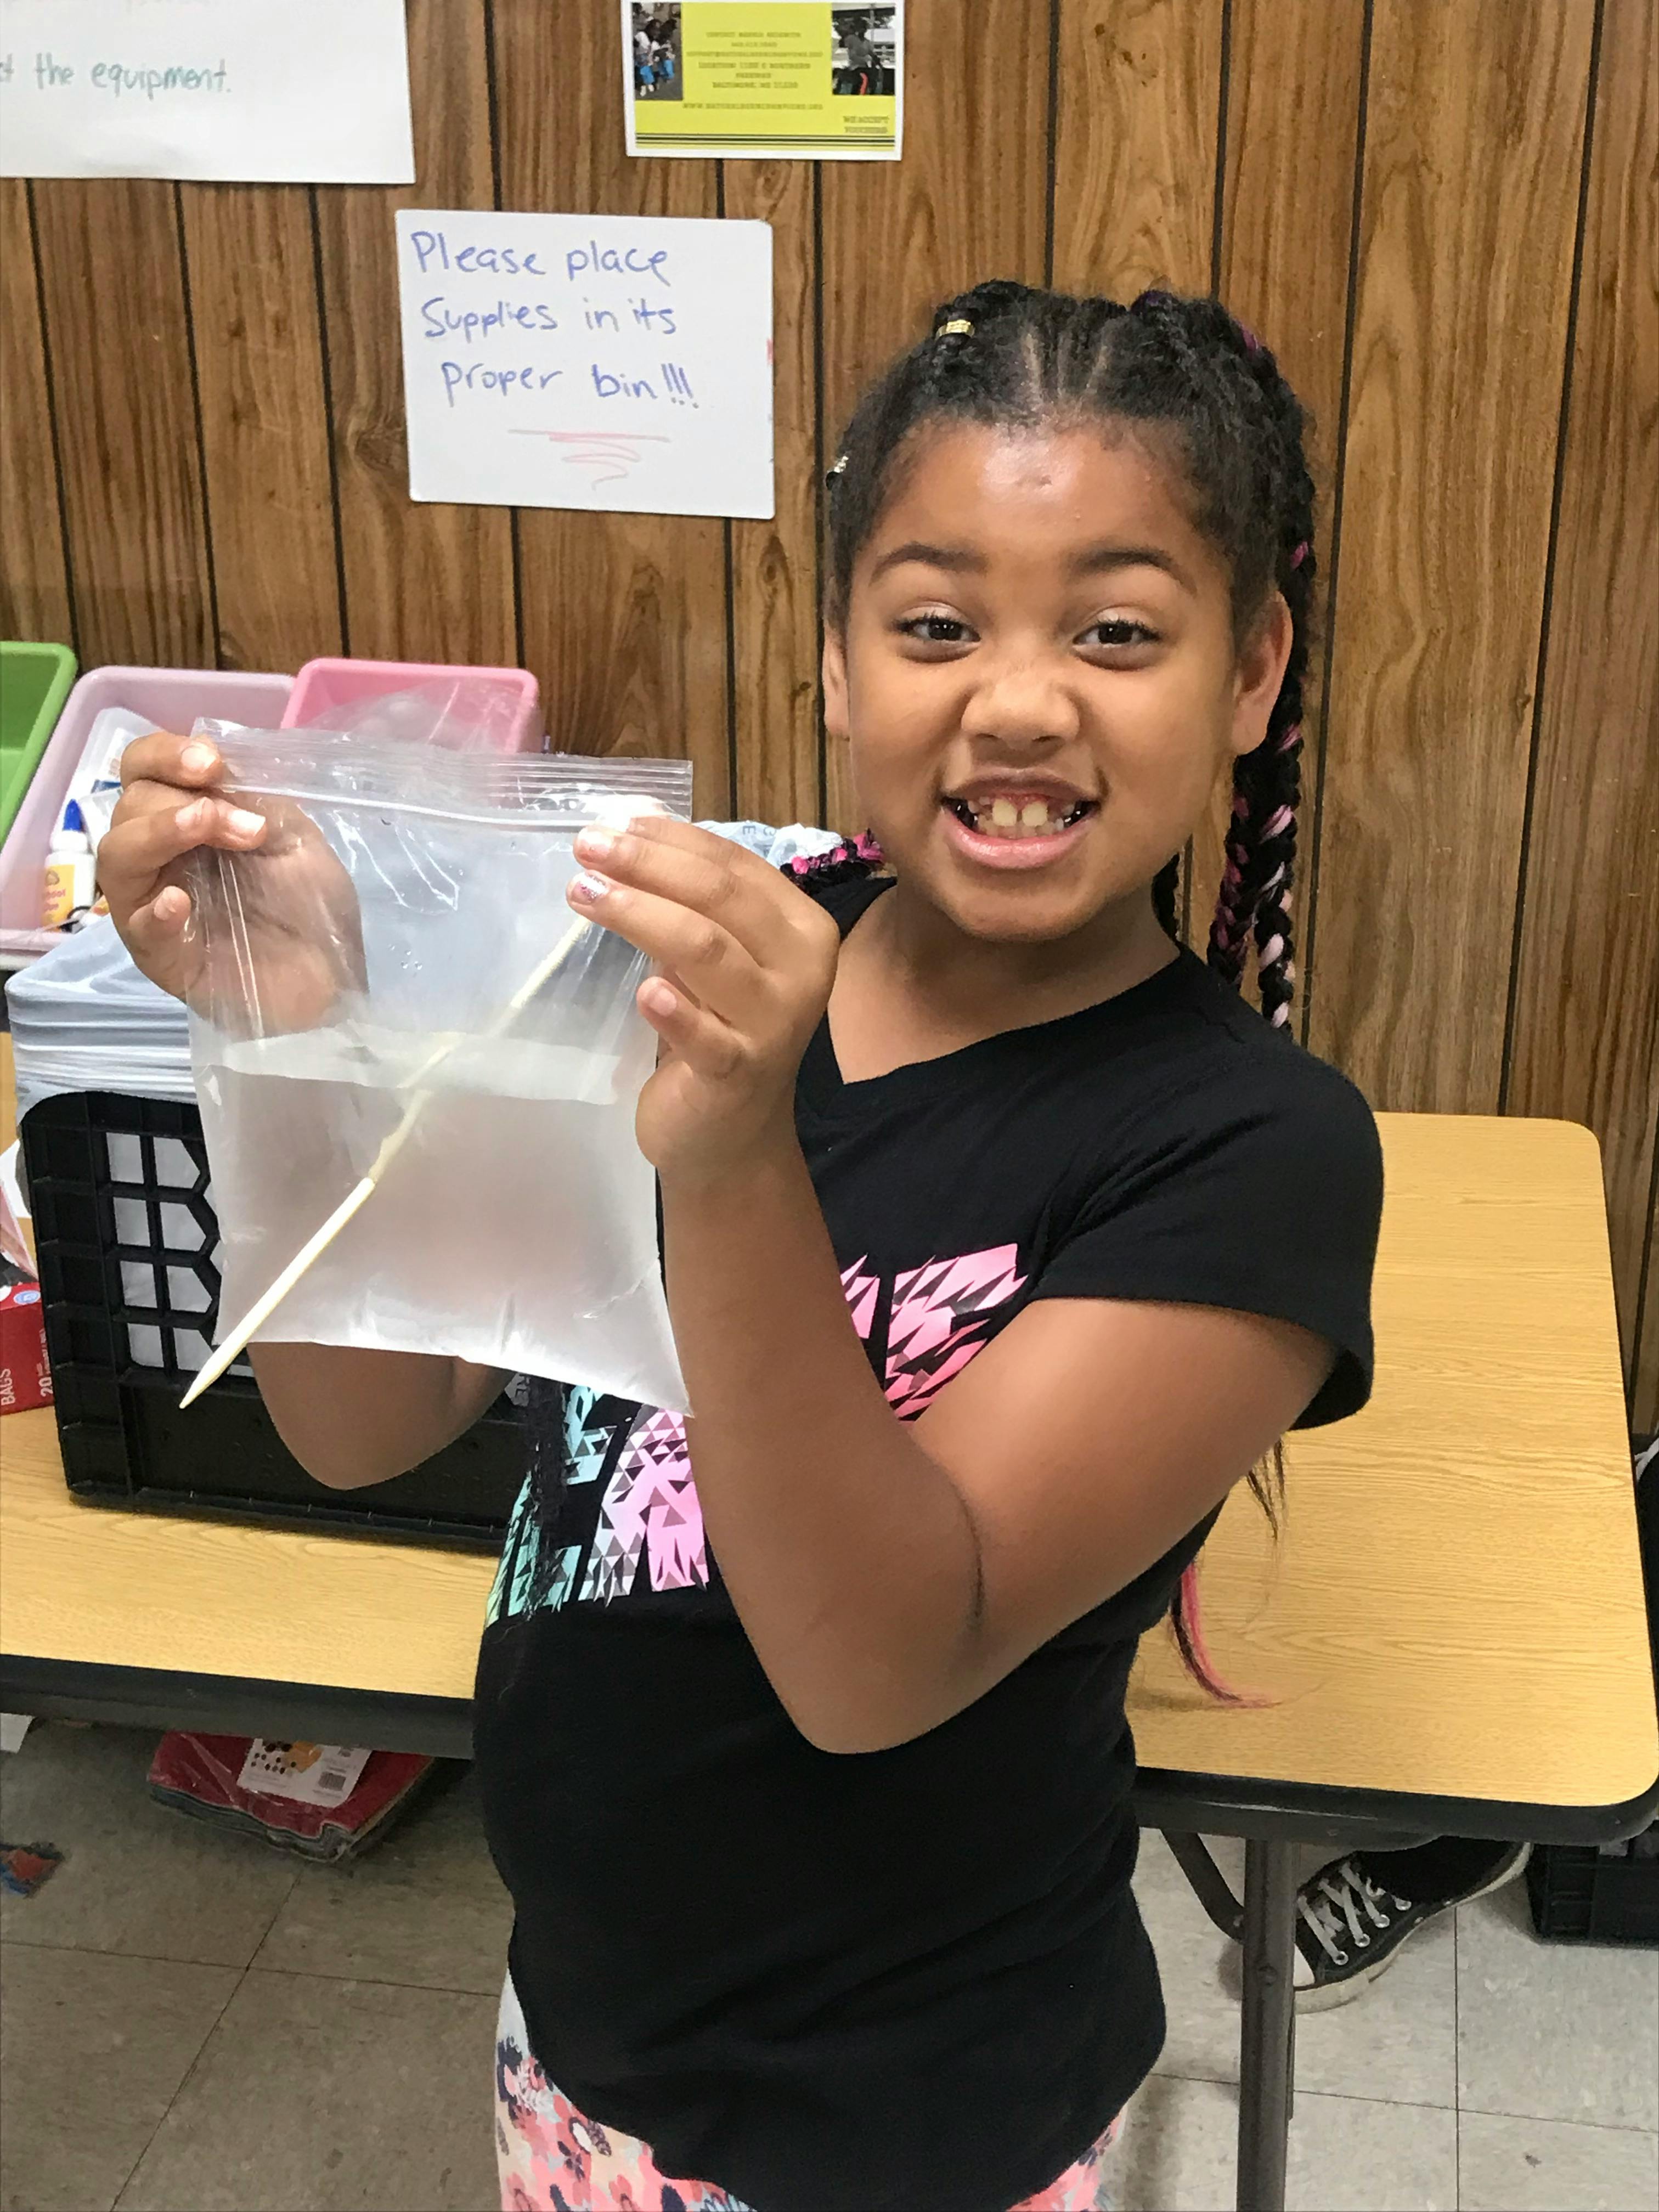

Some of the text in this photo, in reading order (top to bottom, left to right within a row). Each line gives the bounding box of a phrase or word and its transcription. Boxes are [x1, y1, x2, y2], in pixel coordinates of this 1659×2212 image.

[35, 52, 75, 89] the
[91, 58, 232, 101] equipment.
[410, 231, 671, 287] Please place
[421, 297, 677, 343] Supplies in its
[441, 362, 564, 408] proper
[0, 1368, 16, 1406] BAGS
